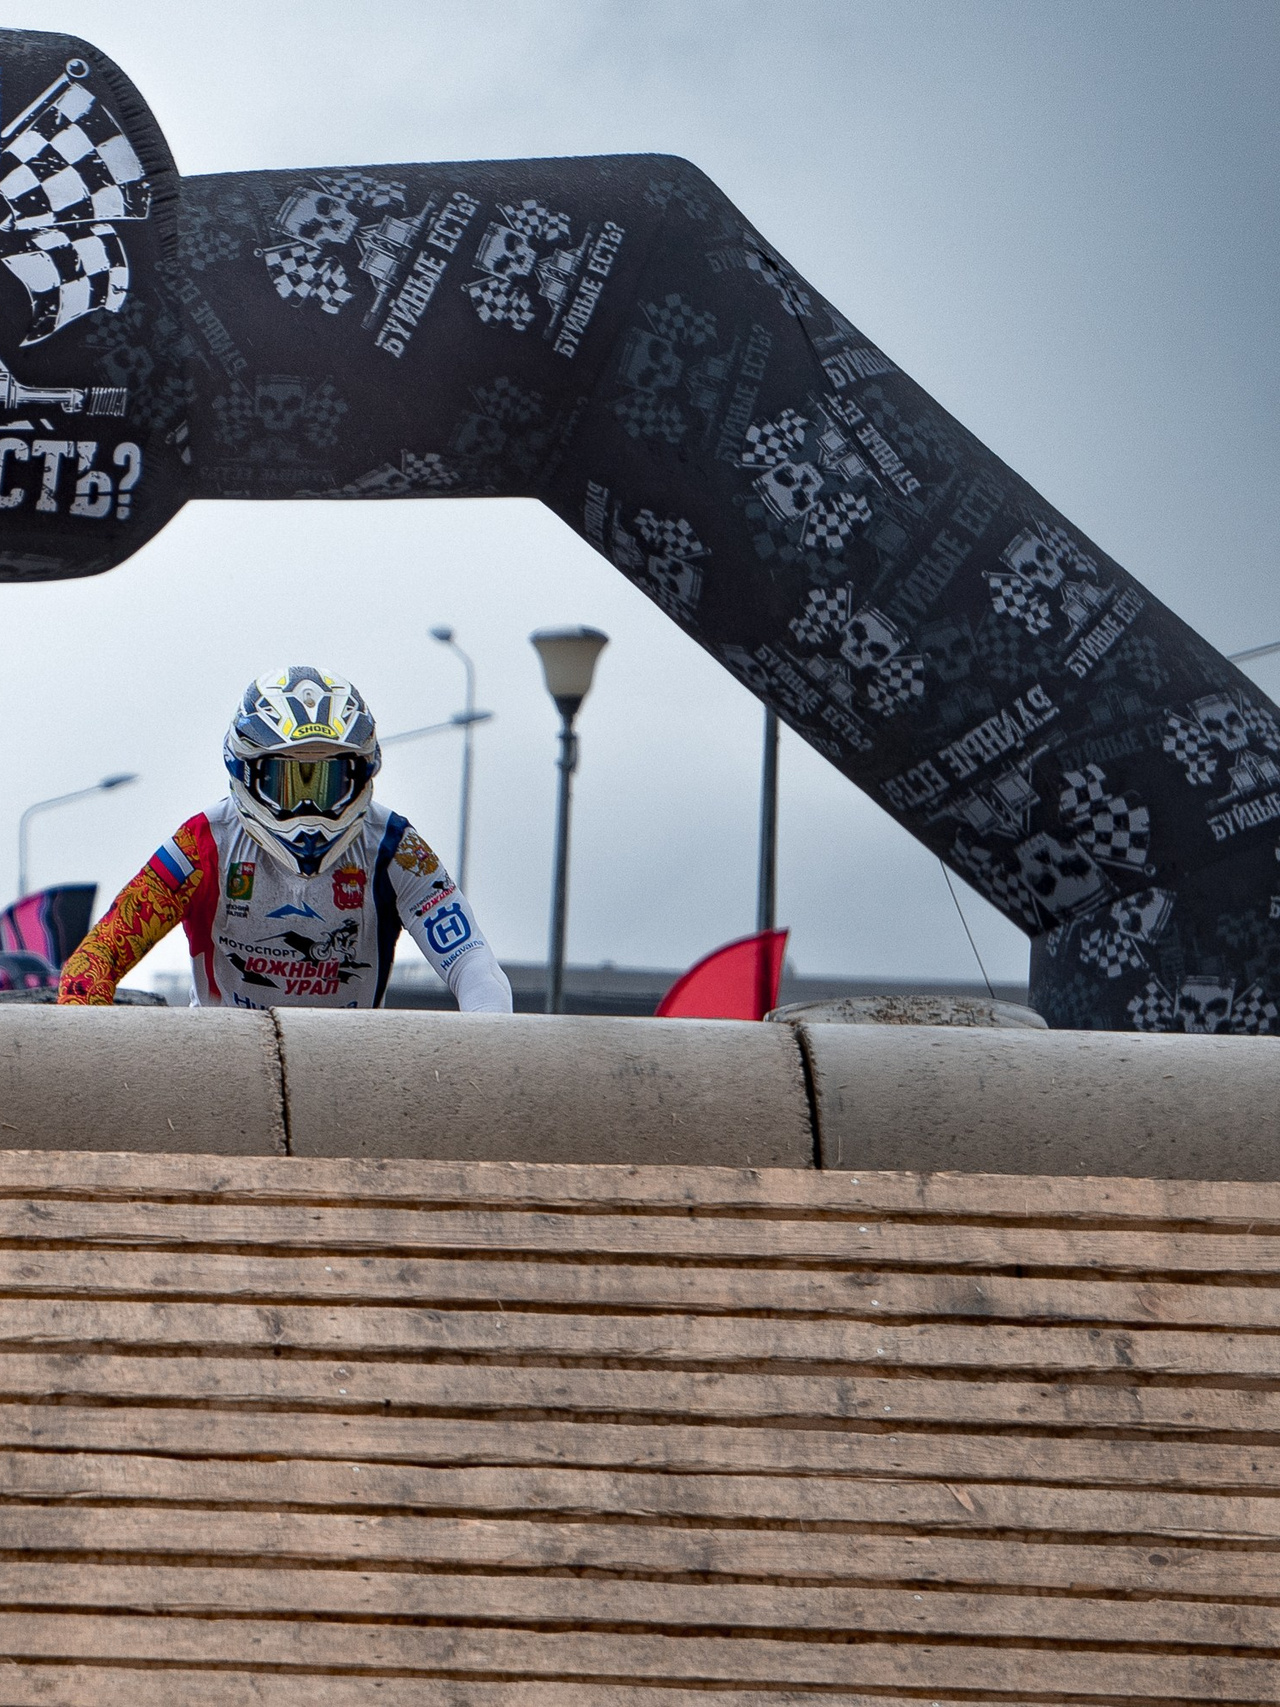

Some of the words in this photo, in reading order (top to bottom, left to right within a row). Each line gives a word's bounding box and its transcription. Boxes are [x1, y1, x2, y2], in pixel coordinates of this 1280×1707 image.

[374, 250, 449, 359] БУЙНЫЕ
[426, 191, 481, 254] ЕСТЬ?
[553, 276, 604, 359] БУЙНЫЕ
[586, 220, 626, 277] ЕСТЬ?
[296, 725, 333, 737] SHOEI
[937, 683, 1061, 781] БУЙНЫЕ
[218, 935, 298, 958] МОТОСПОРТ
[243, 956, 341, 980] ЮЖНЫЙ
[284, 977, 340, 996] УРАЛ
